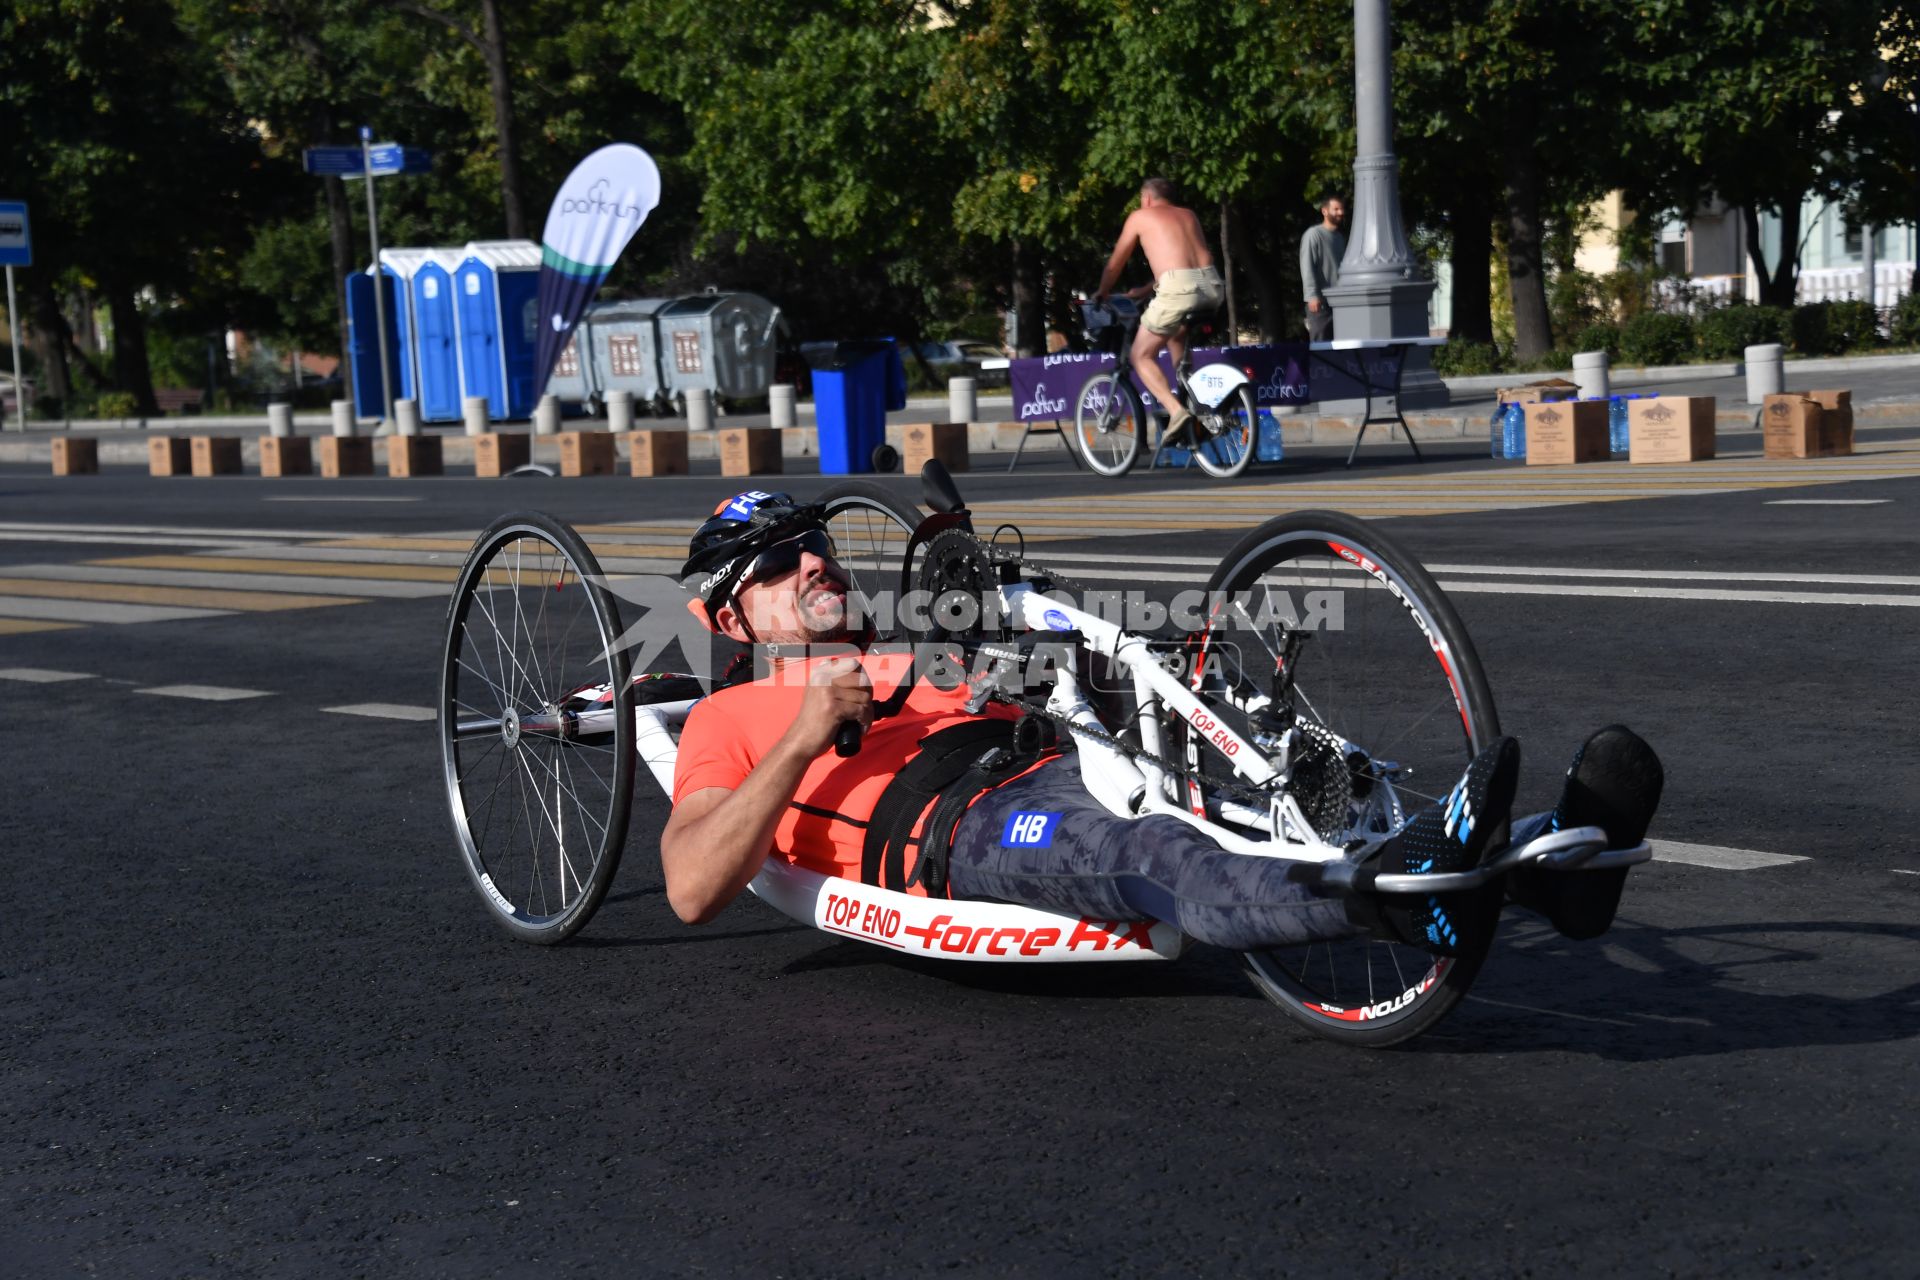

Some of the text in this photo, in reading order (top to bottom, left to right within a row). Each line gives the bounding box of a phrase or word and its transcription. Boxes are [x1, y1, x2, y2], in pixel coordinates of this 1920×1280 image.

[561, 188, 640, 220] parkrun
[700, 559, 736, 593] RUDY
[1360, 557, 1446, 652] EASTON
[984, 647, 1028, 663] SRAM
[1189, 708, 1240, 756] TOP END
[1010, 815, 1048, 843] HB
[825, 894, 901, 939] TOP END
[905, 915, 1061, 957] force
[1358, 962, 1438, 1021] EASTON
